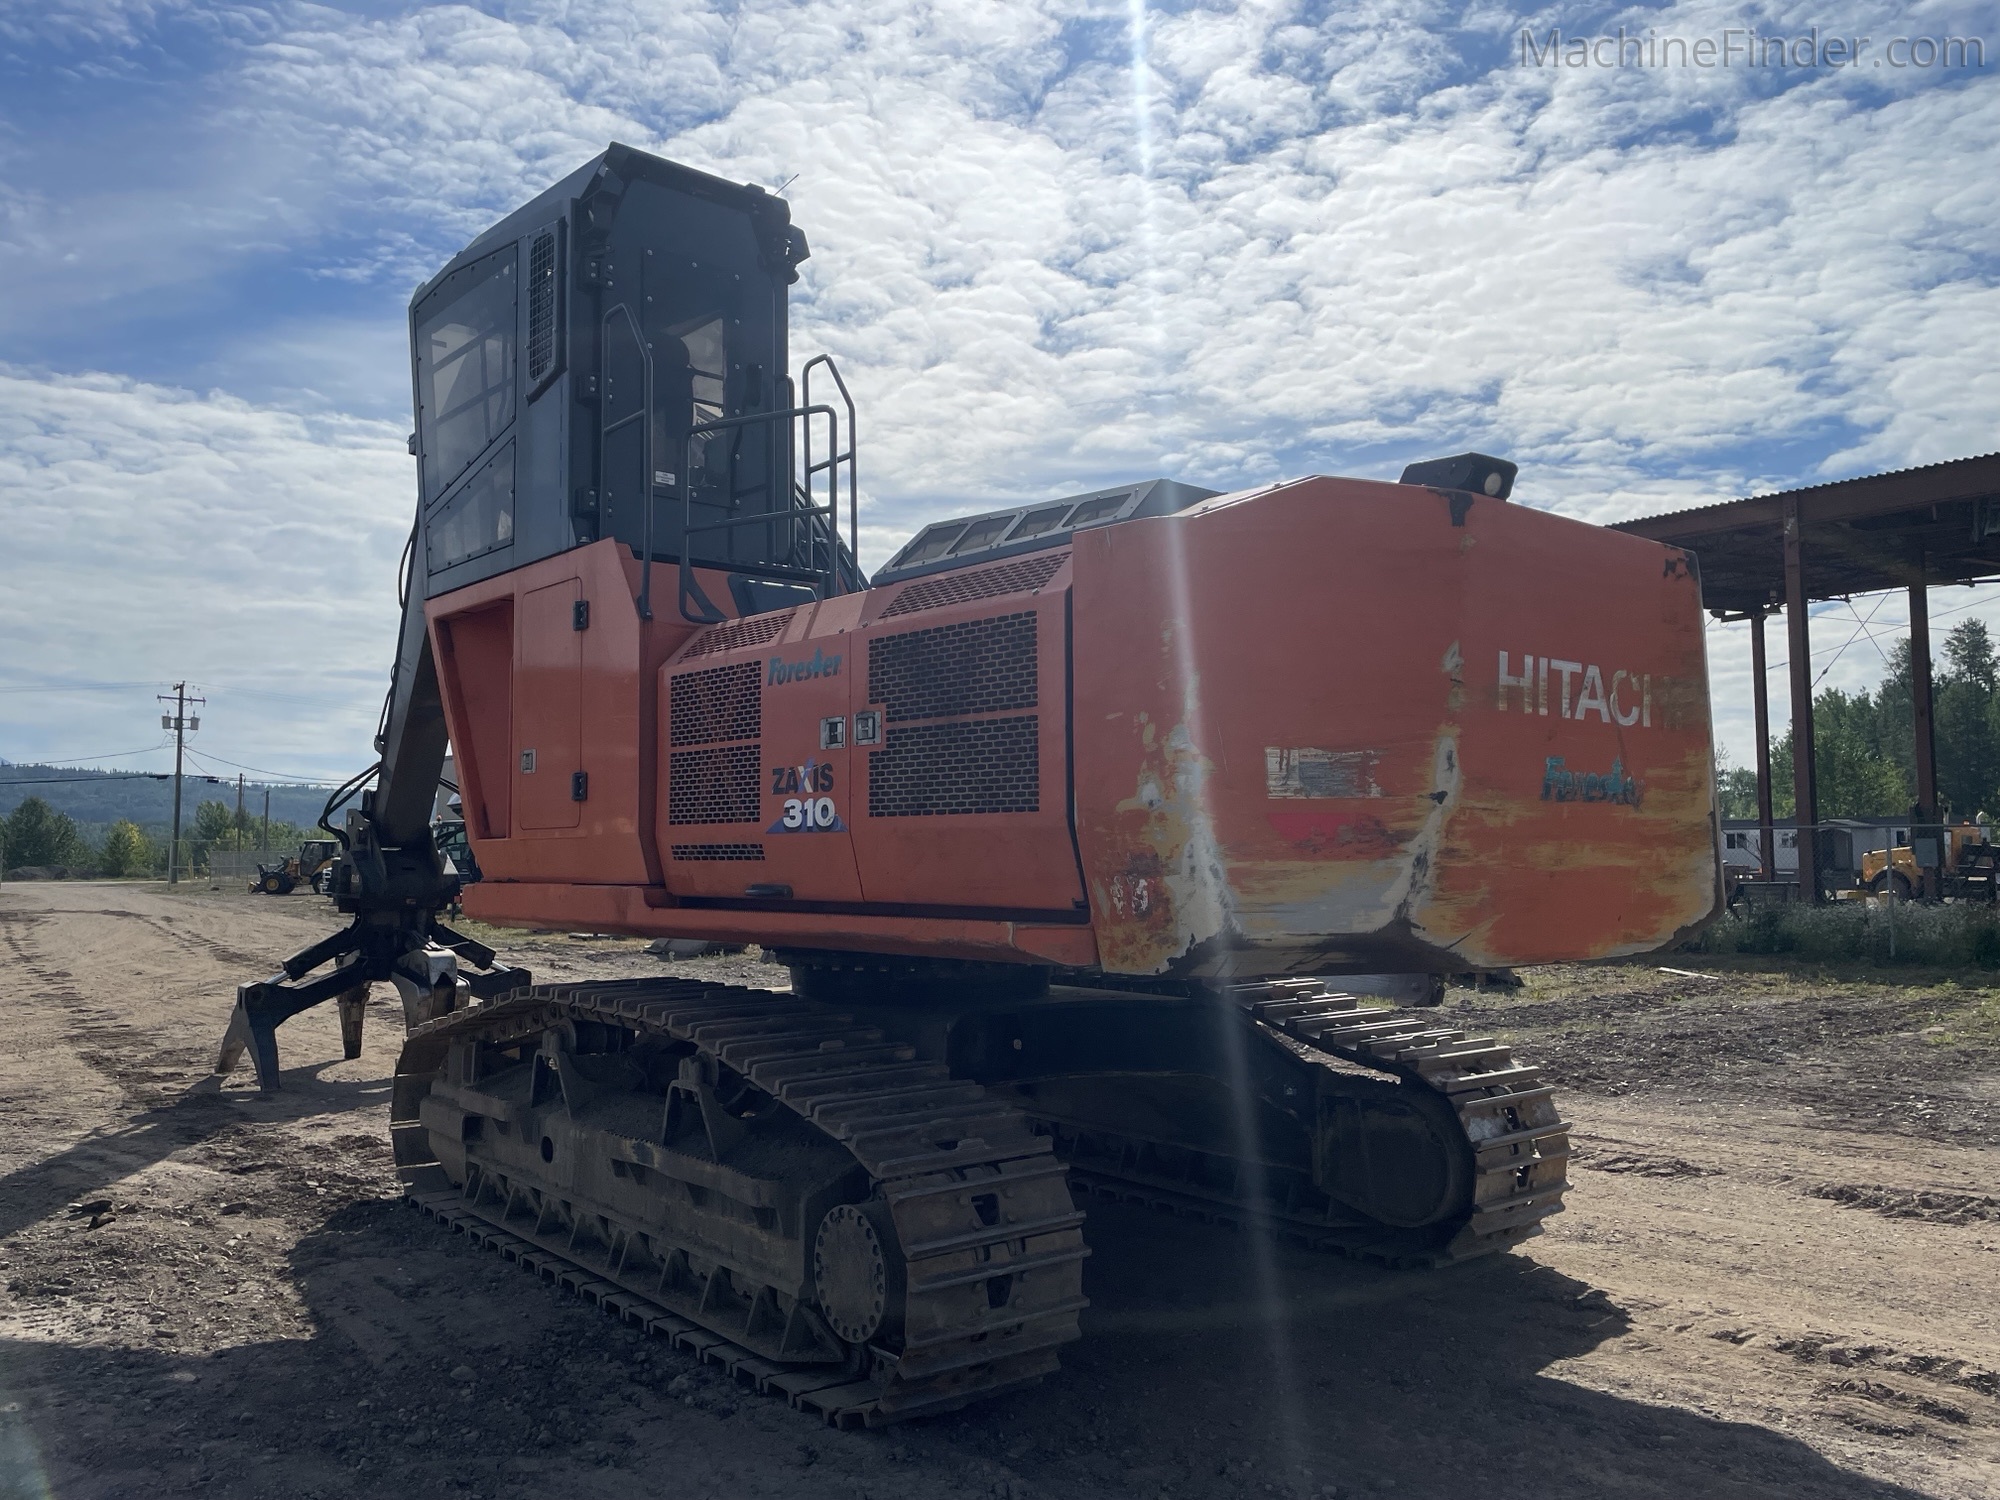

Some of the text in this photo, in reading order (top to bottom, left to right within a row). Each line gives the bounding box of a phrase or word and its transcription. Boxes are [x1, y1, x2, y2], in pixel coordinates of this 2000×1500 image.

[767, 647, 842, 687] Forester
[1498, 650, 1652, 728] HITAC
[772, 757, 834, 796] ZAXIS
[783, 797, 836, 830] 310
